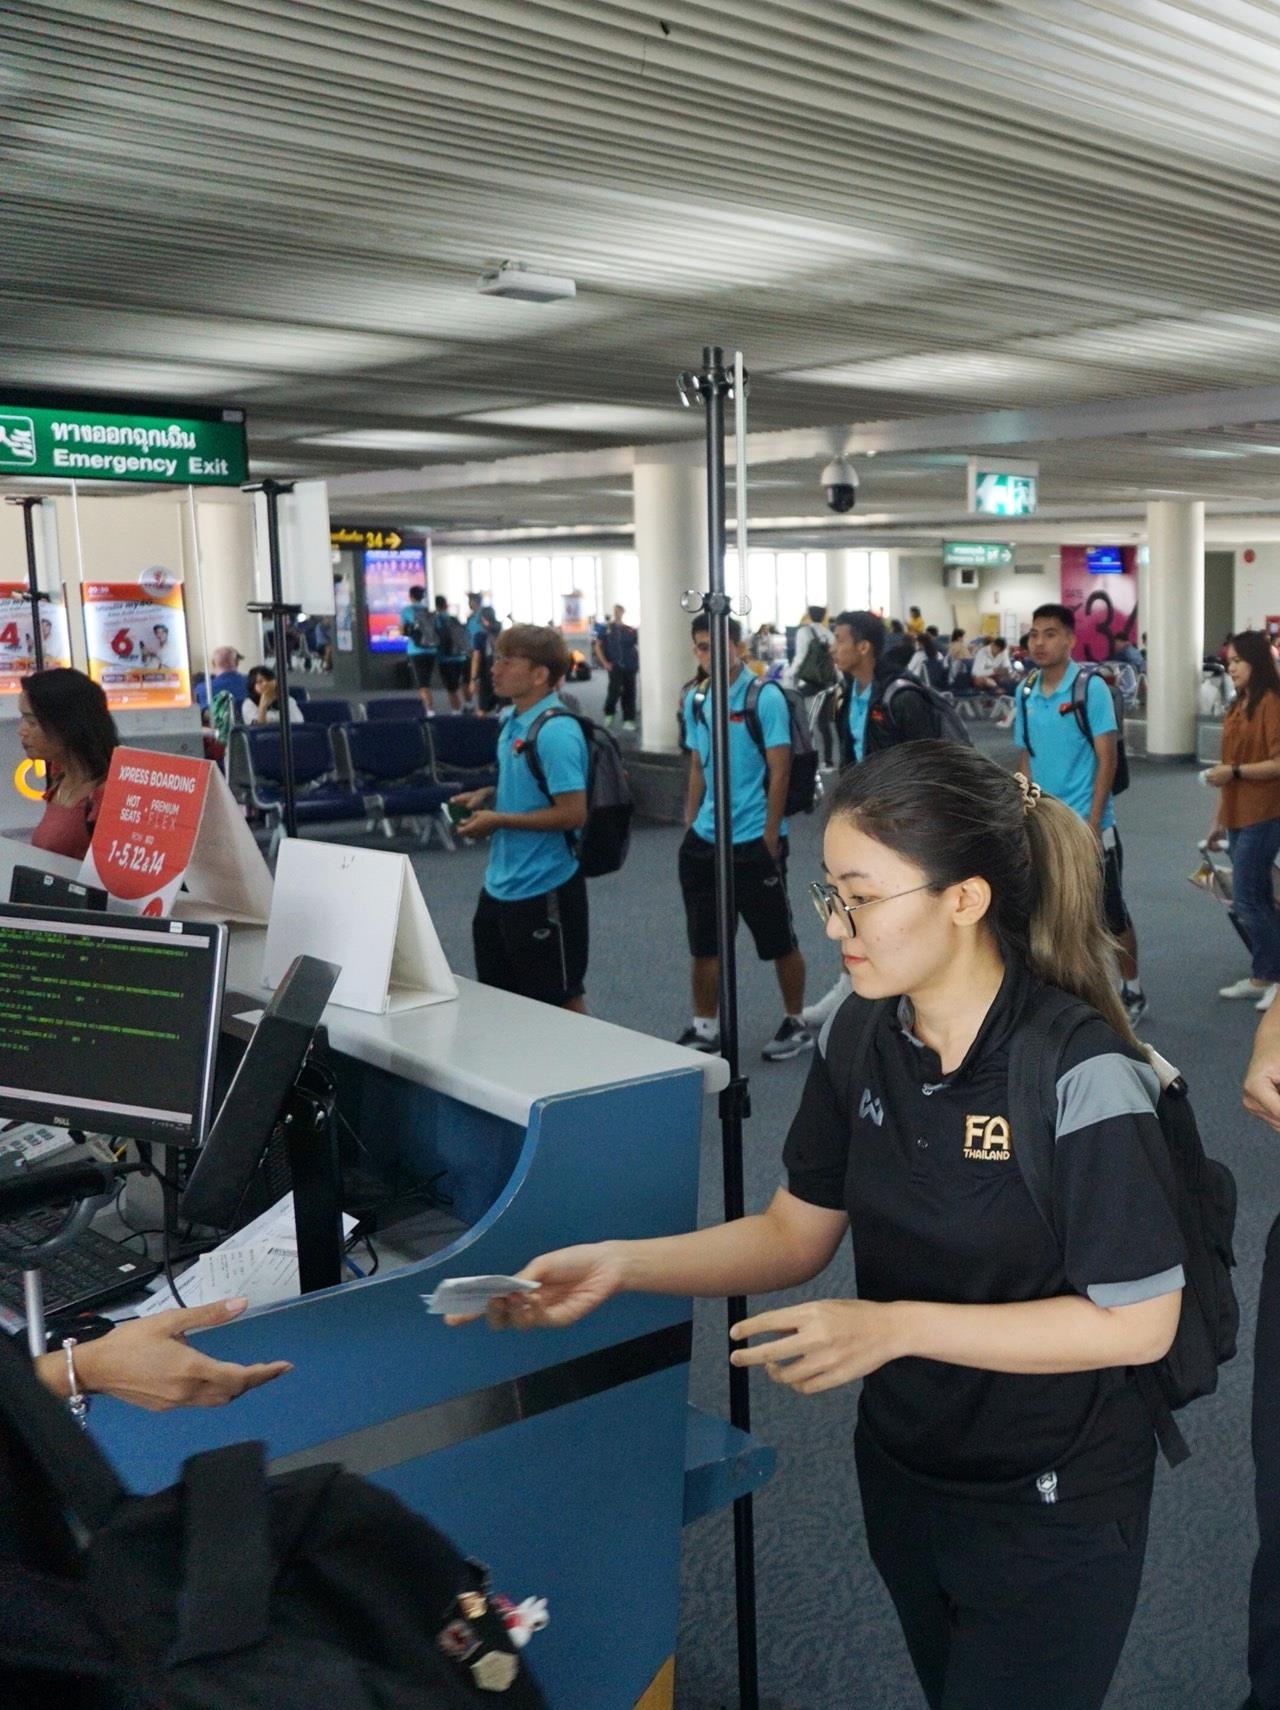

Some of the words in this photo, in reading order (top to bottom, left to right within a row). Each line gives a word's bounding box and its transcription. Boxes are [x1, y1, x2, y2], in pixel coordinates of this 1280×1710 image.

[50, 421, 196, 453] ทางออกฉุกเฉิน
[53, 448, 177, 476] Emergency
[188, 456, 229, 475] Exit
[110, 628, 134, 657] 6
[118, 766, 150, 786] XPRESS
[150, 772, 196, 795] BOARDING
[126, 794, 142, 809] HOT
[151, 799, 180, 815] PREMIUM
[119, 808, 142, 825] SEATS
[53, 1116, 70, 1126] DELL
[964, 1115, 1012, 1150] FA
[963, 1148, 1011, 1161] THAILAND
